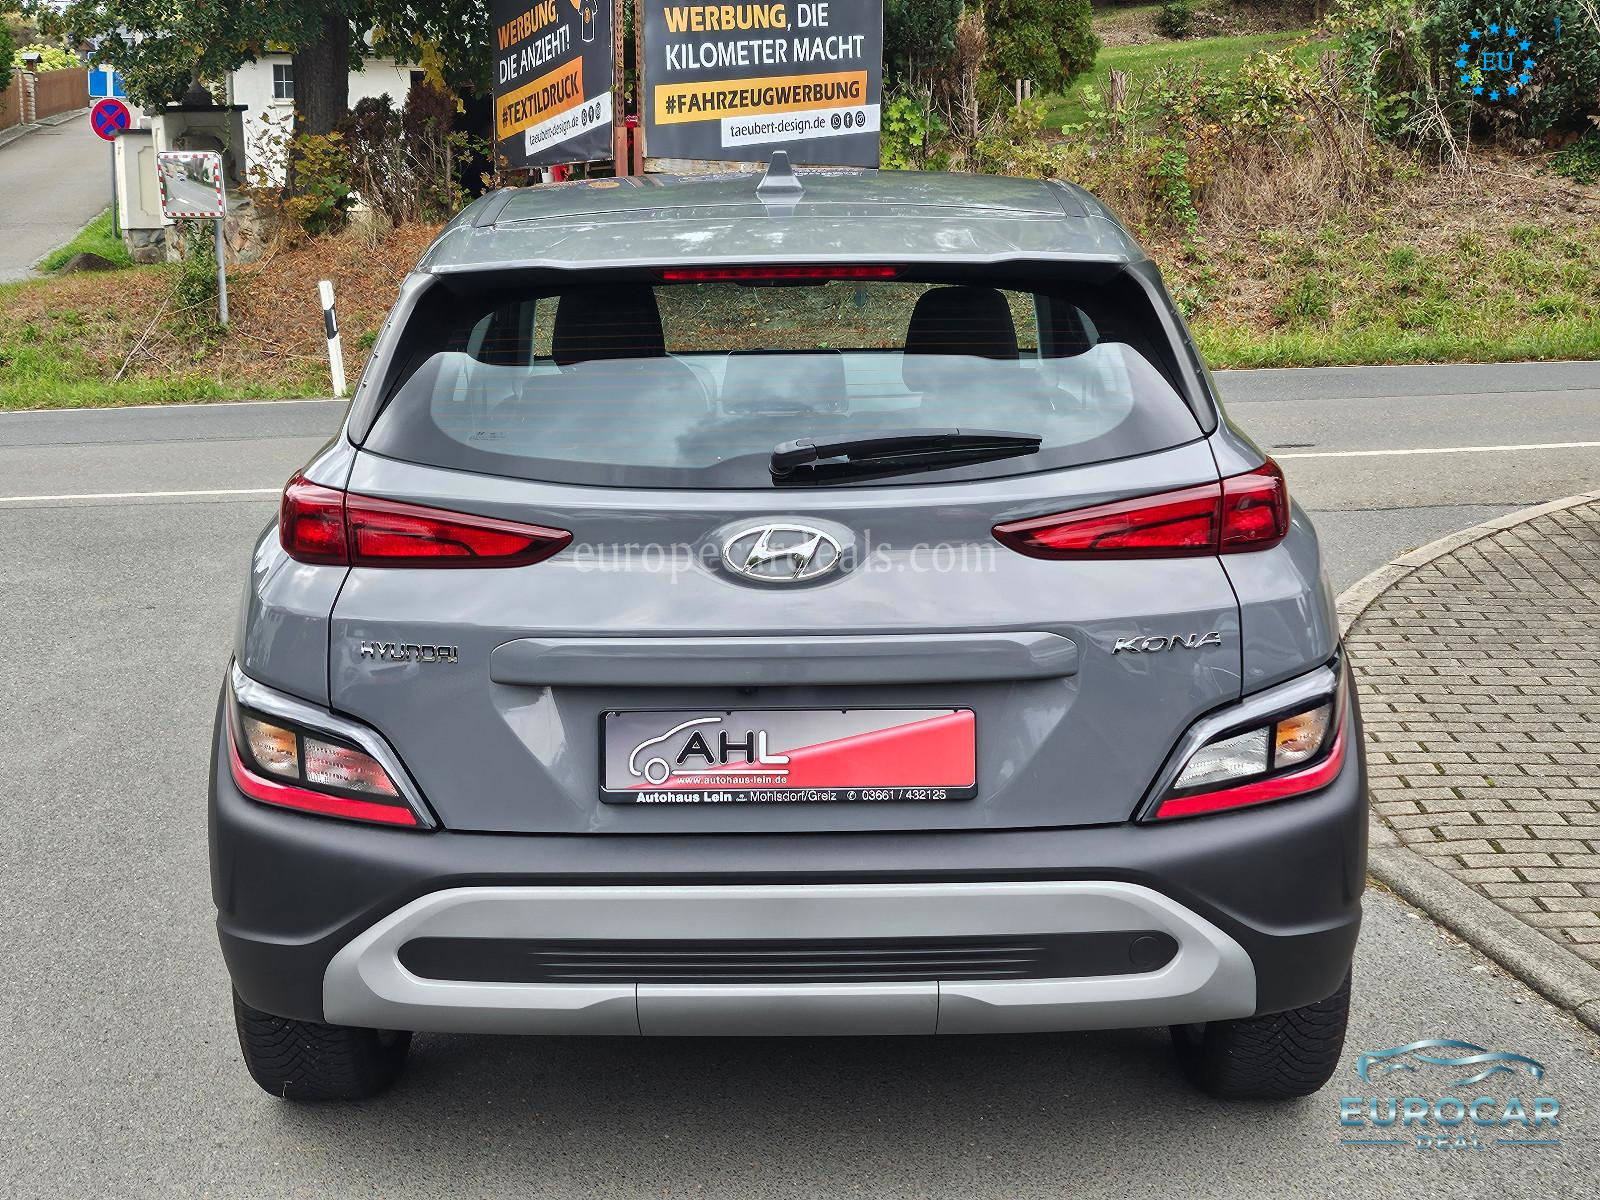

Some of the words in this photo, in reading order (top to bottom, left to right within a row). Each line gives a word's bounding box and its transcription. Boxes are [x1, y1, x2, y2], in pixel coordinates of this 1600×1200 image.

[498, 0, 559, 50] WERBUNG,
[664, 4, 791, 33] WERBUNG,
[797, 3, 829, 27] DIE
[500, 53, 518, 85] DIE
[520, 24, 570, 75] ANZIEHT!
[665, 38, 788, 70] KILOMETER
[793, 35, 865, 62] MACHT
[502, 71, 579, 128] #TEXTILDRUCK
[665, 80, 860, 114] #FAHRZEUGWERBUNG
[730, 116, 826, 137] taeubert-design.de
[360, 641, 458, 663] HYUNDAI
[1112, 631, 1221, 655] KONA
[675, 729, 790, 765] AHL
[636, 791, 700, 803] Autohaus
[703, 791, 732, 802] Lein
[861, 789, 894, 801] 03661
[905, 789, 946, 800] 432125
[677, 775, 787, 785] www.autohaus-lein.de
